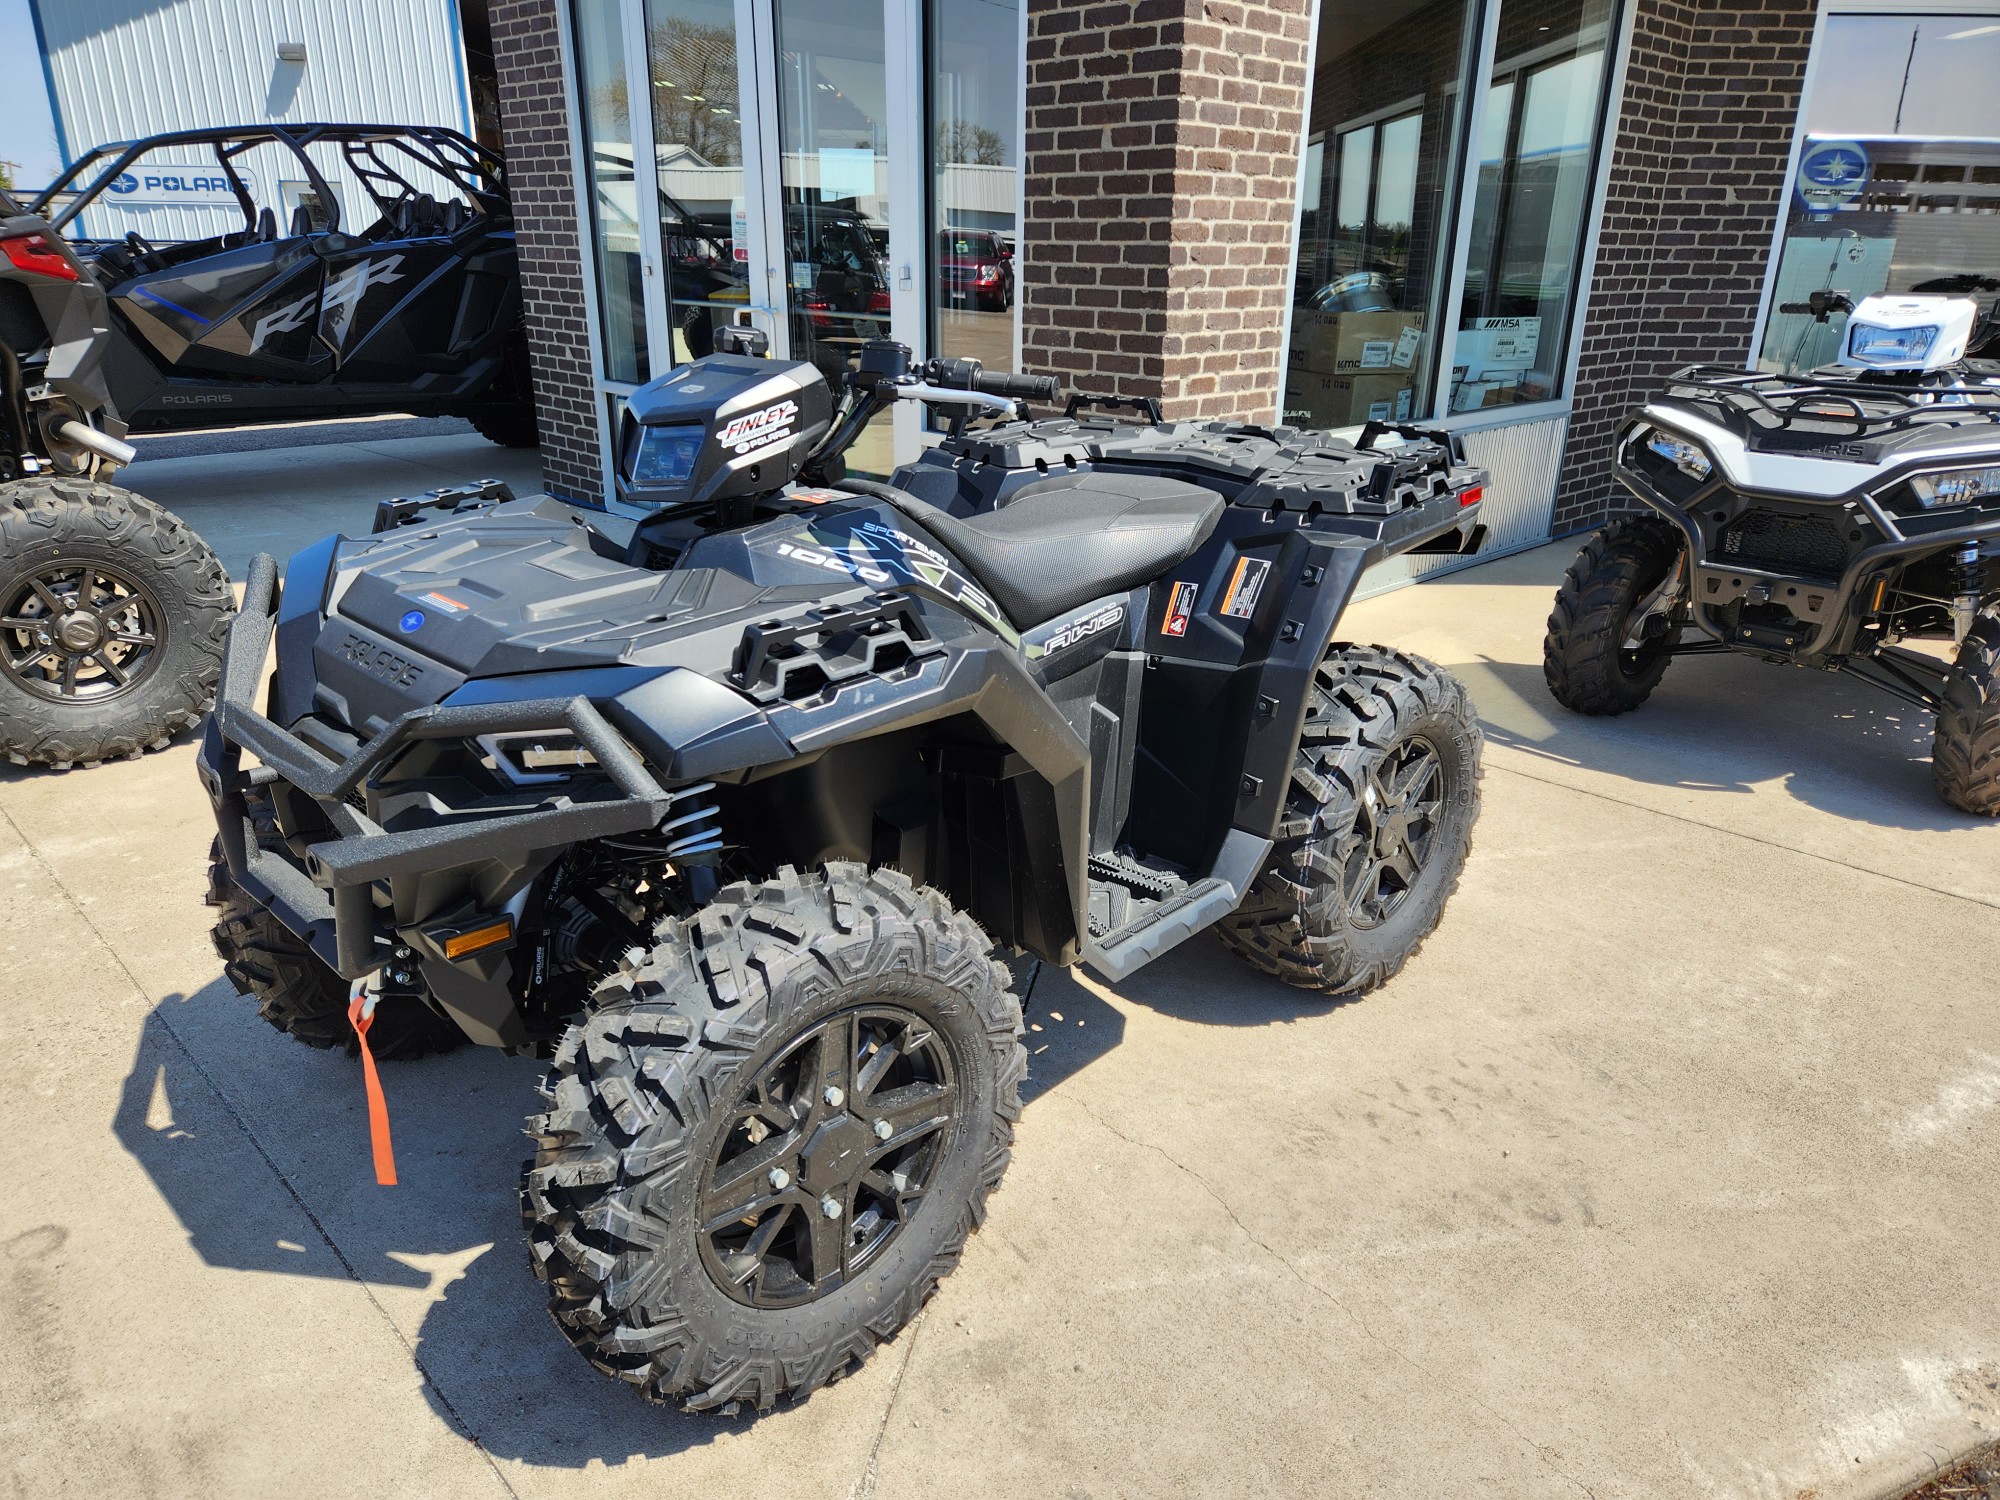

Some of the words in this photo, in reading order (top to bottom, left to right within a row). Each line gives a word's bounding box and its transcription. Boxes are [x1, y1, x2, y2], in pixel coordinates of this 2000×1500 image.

[1804, 188, 1857, 197] POLARIS
[1501, 319, 1520, 328] MSA
[162, 394, 233, 404] POLARIS
[719, 400, 797, 441] FINLEY
[750, 427, 791, 449] POLARIS
[777, 543, 890, 583] 1000
[862, 521, 949, 567] SPORTSMAN
[1043, 606, 1124, 657] AWD
[335, 633, 424, 688] POLARIS
